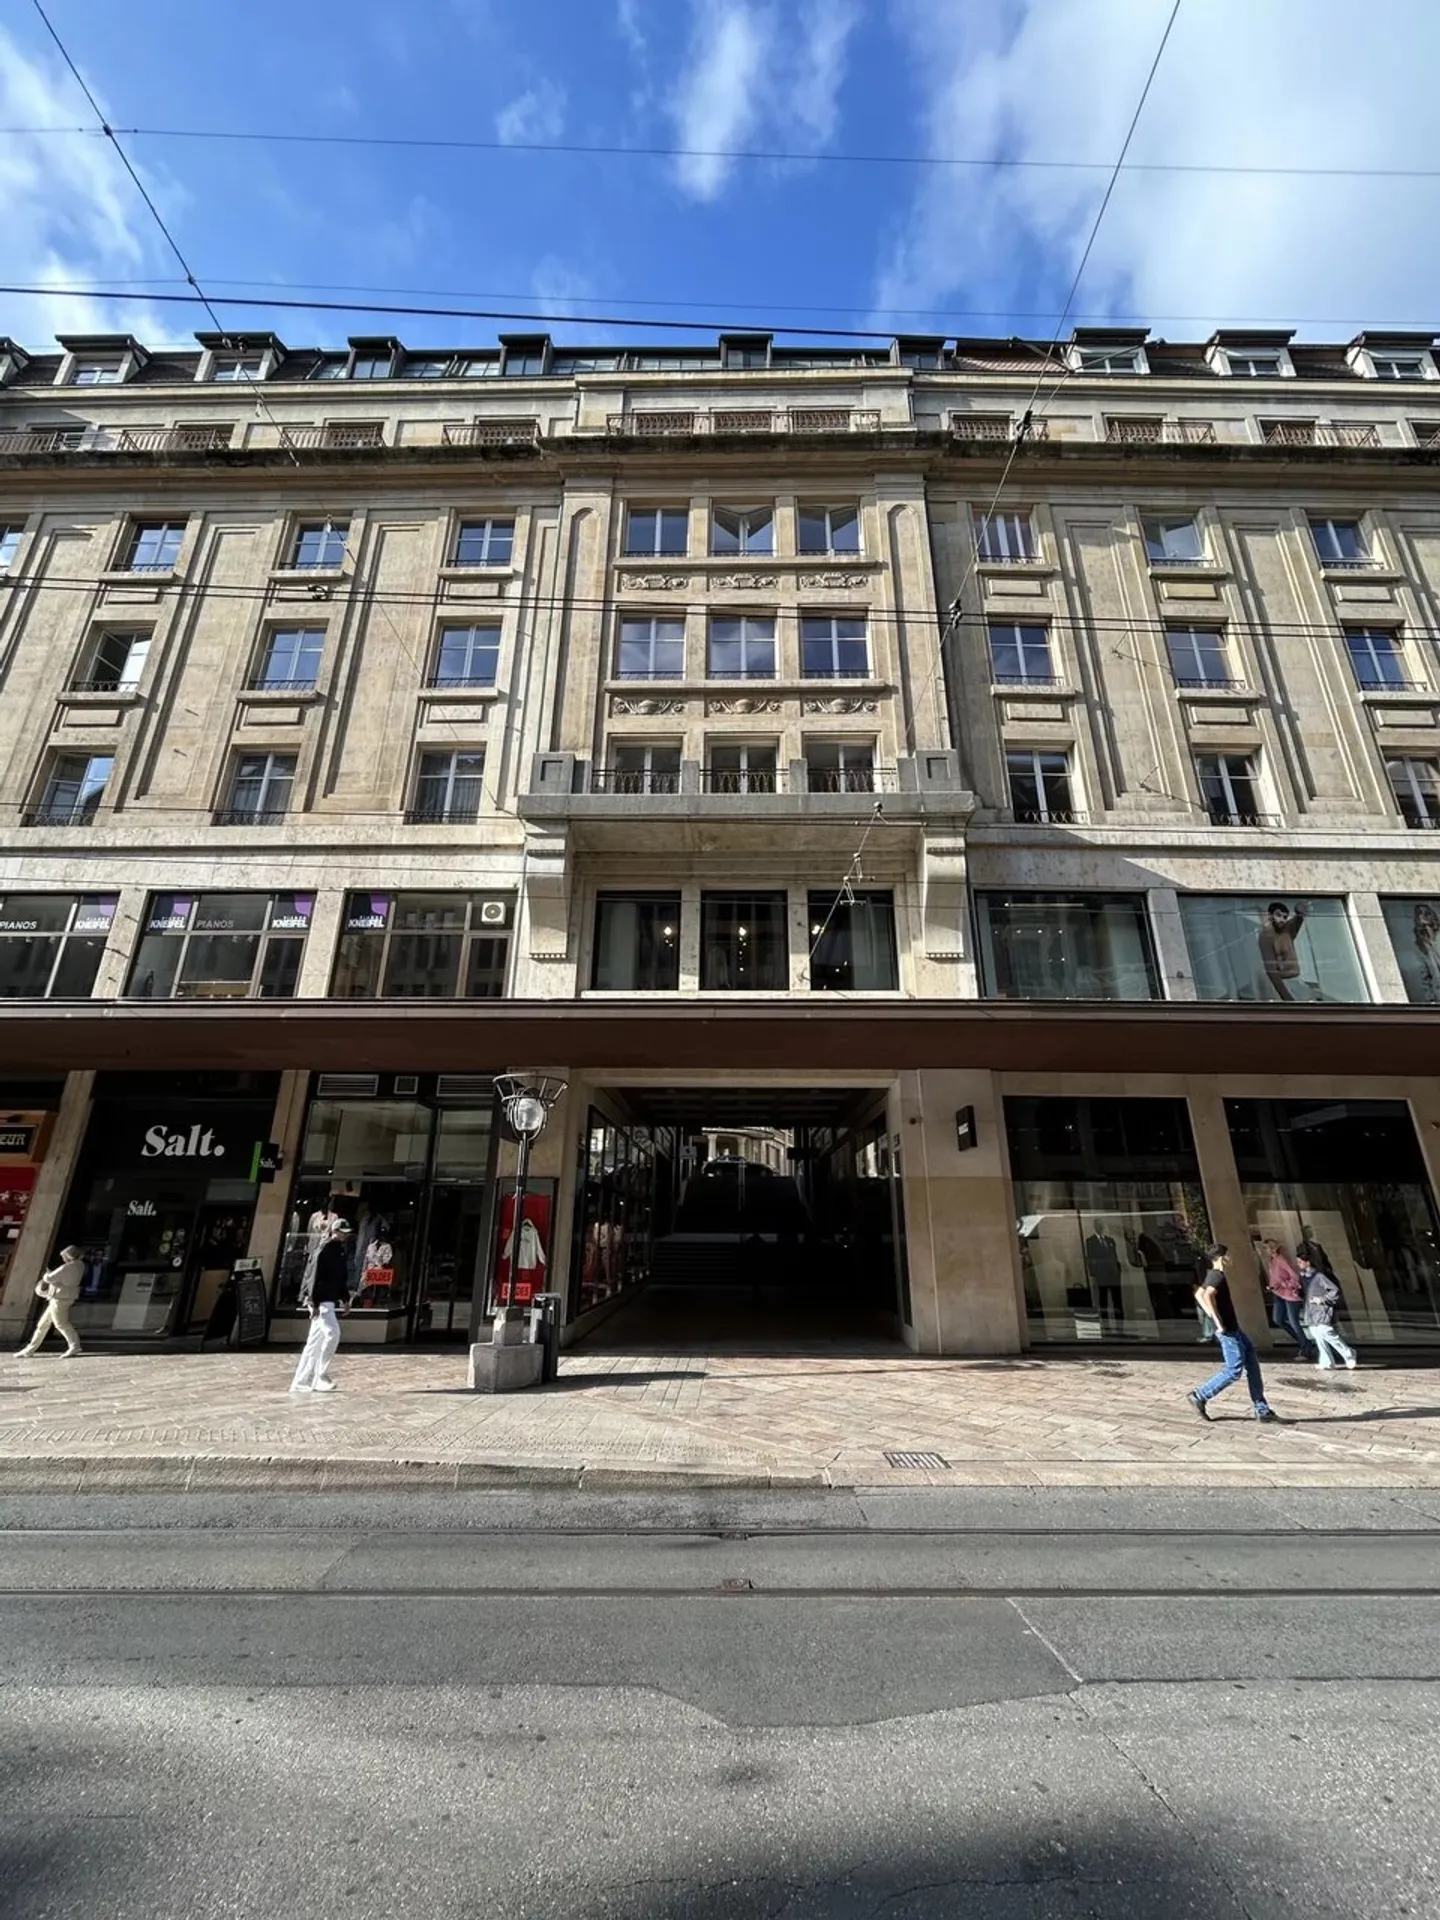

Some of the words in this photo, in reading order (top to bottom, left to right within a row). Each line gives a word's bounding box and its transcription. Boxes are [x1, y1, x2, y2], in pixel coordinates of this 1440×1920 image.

[0, 920, 37, 930] PIANOS
[195, 919, 234, 929] PIANOS
[141, 1124, 225, 1157] Salt.
[127, 1199, 158, 1216] Salt.
[366, 1271, 391, 1282] SOLDES
[503, 1285, 529, 1297] SDES
